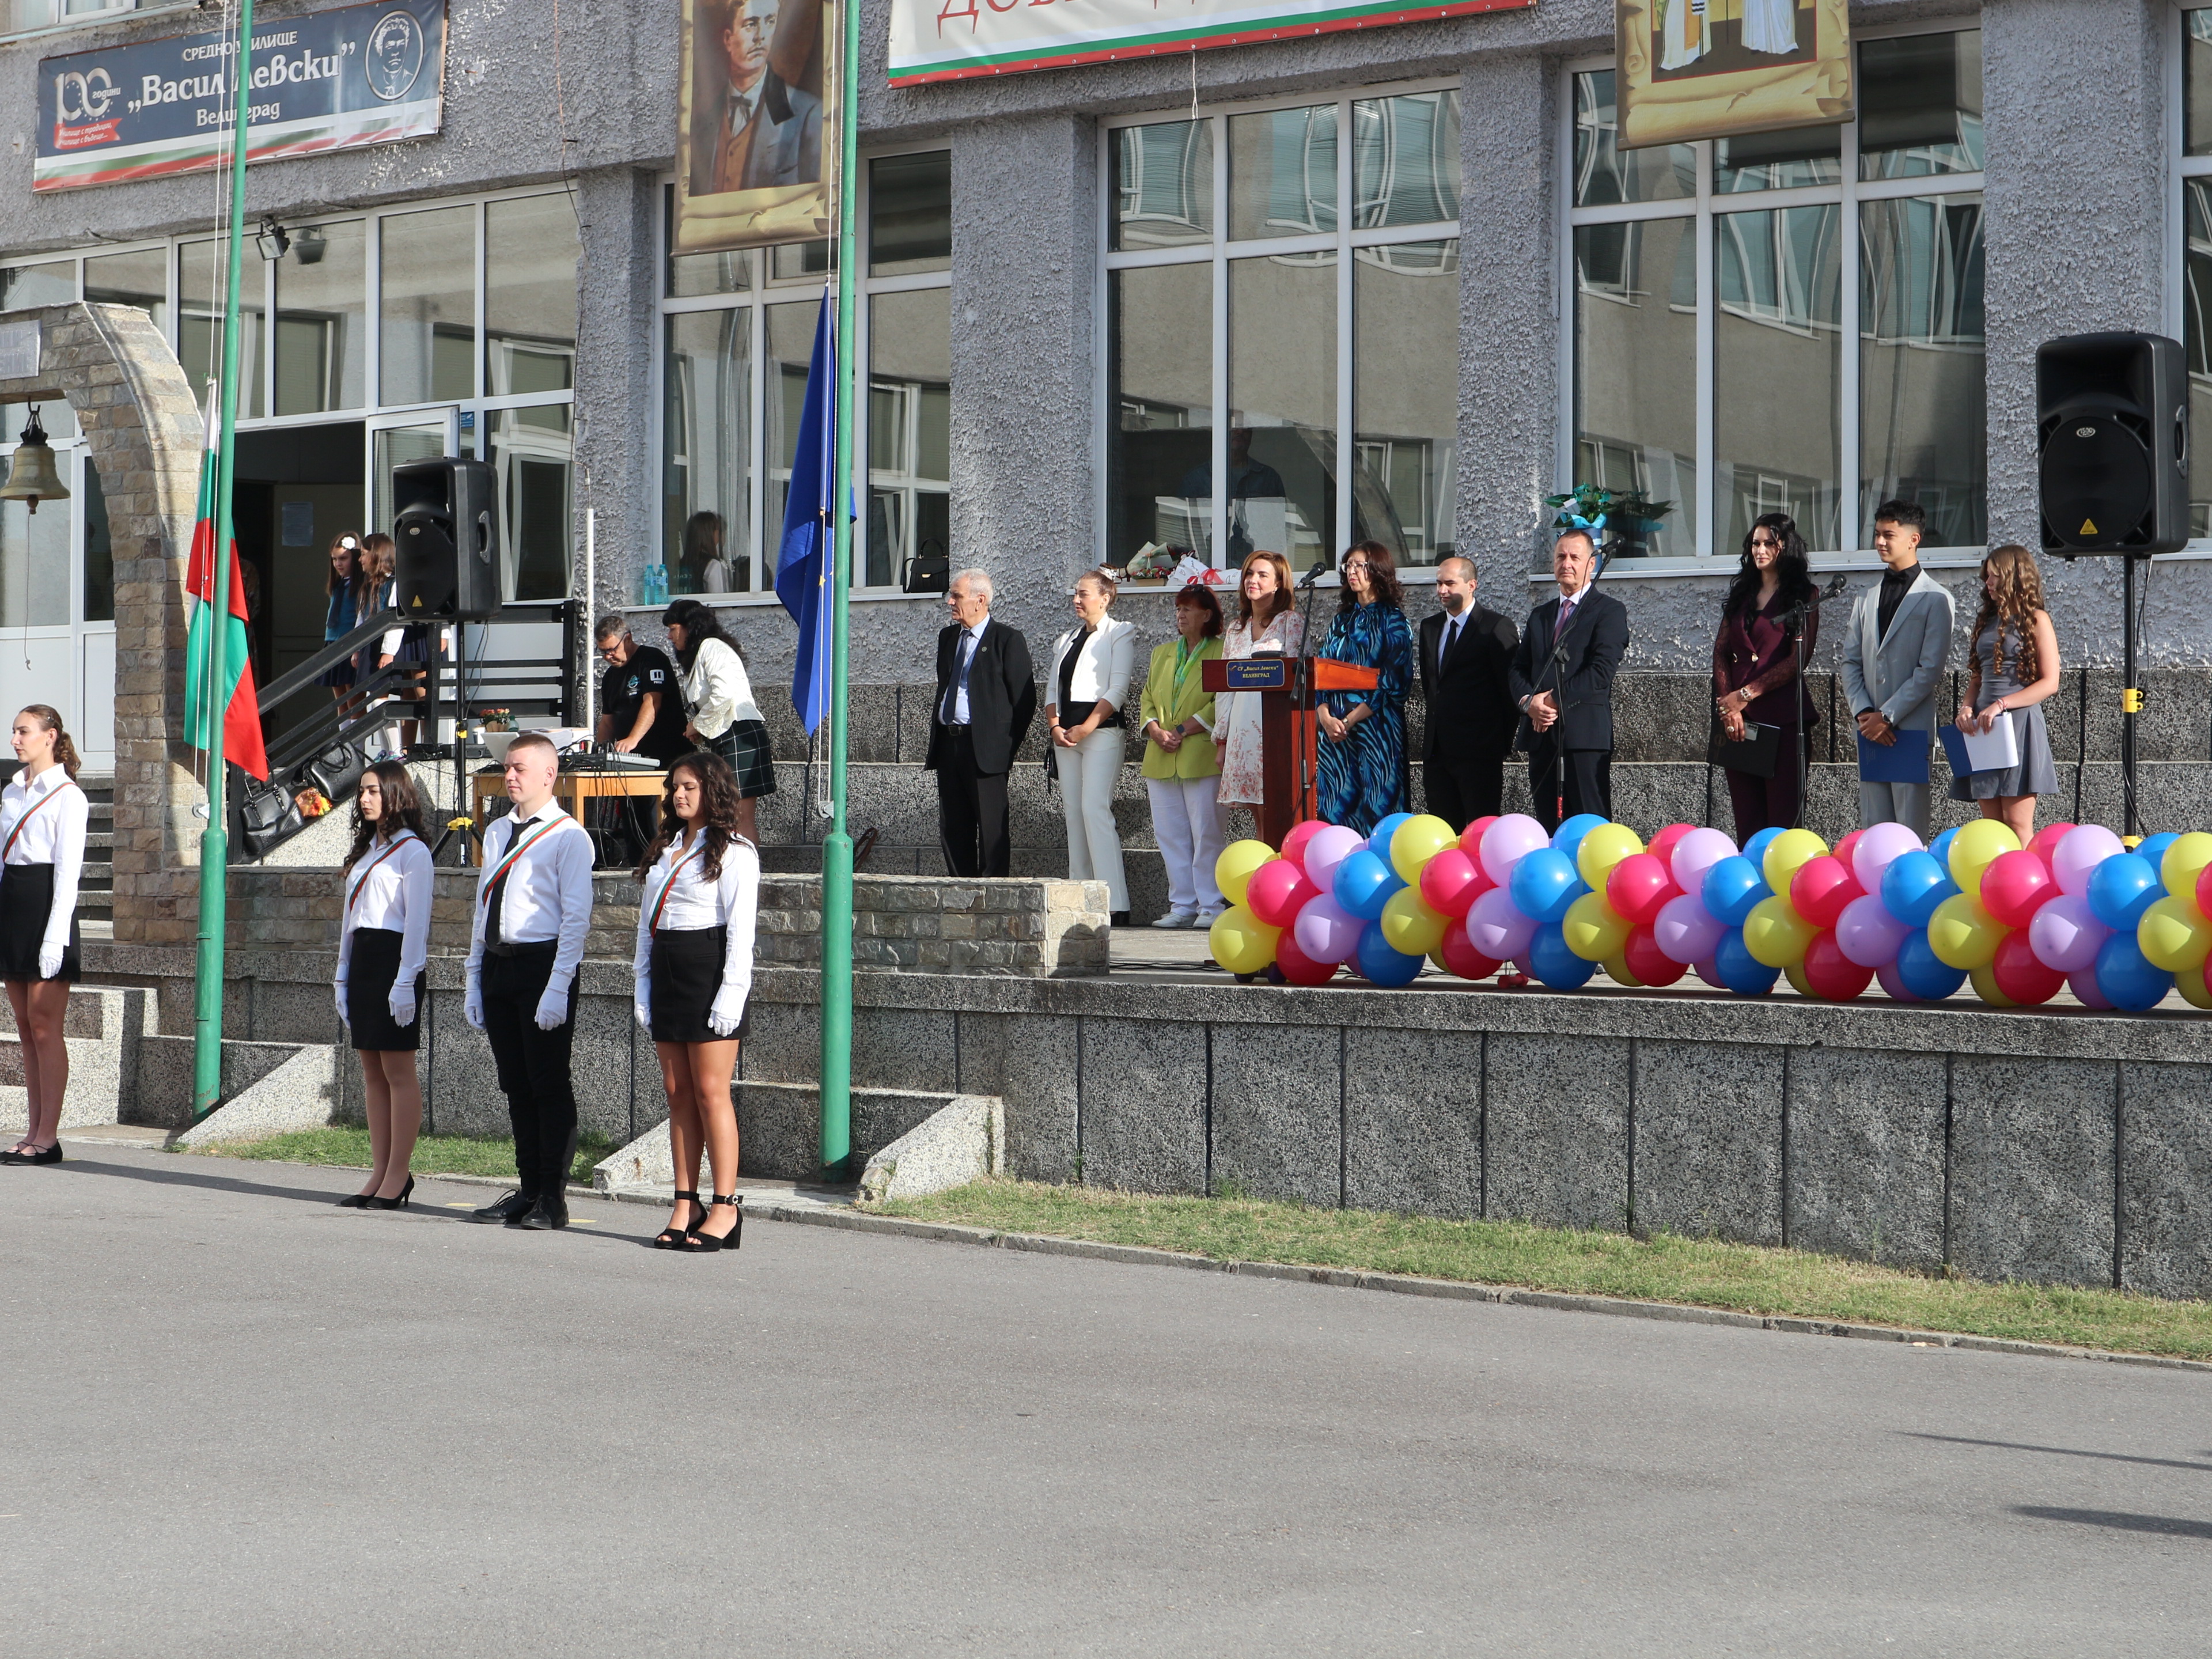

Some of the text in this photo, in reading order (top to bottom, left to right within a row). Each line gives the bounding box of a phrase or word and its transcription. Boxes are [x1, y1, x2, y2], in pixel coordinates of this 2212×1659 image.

[183, 31, 298, 62] СРЕДНО УИЛИЩЕ
[92, 87, 121, 100] години
[196, 101, 281, 127] Велиград
